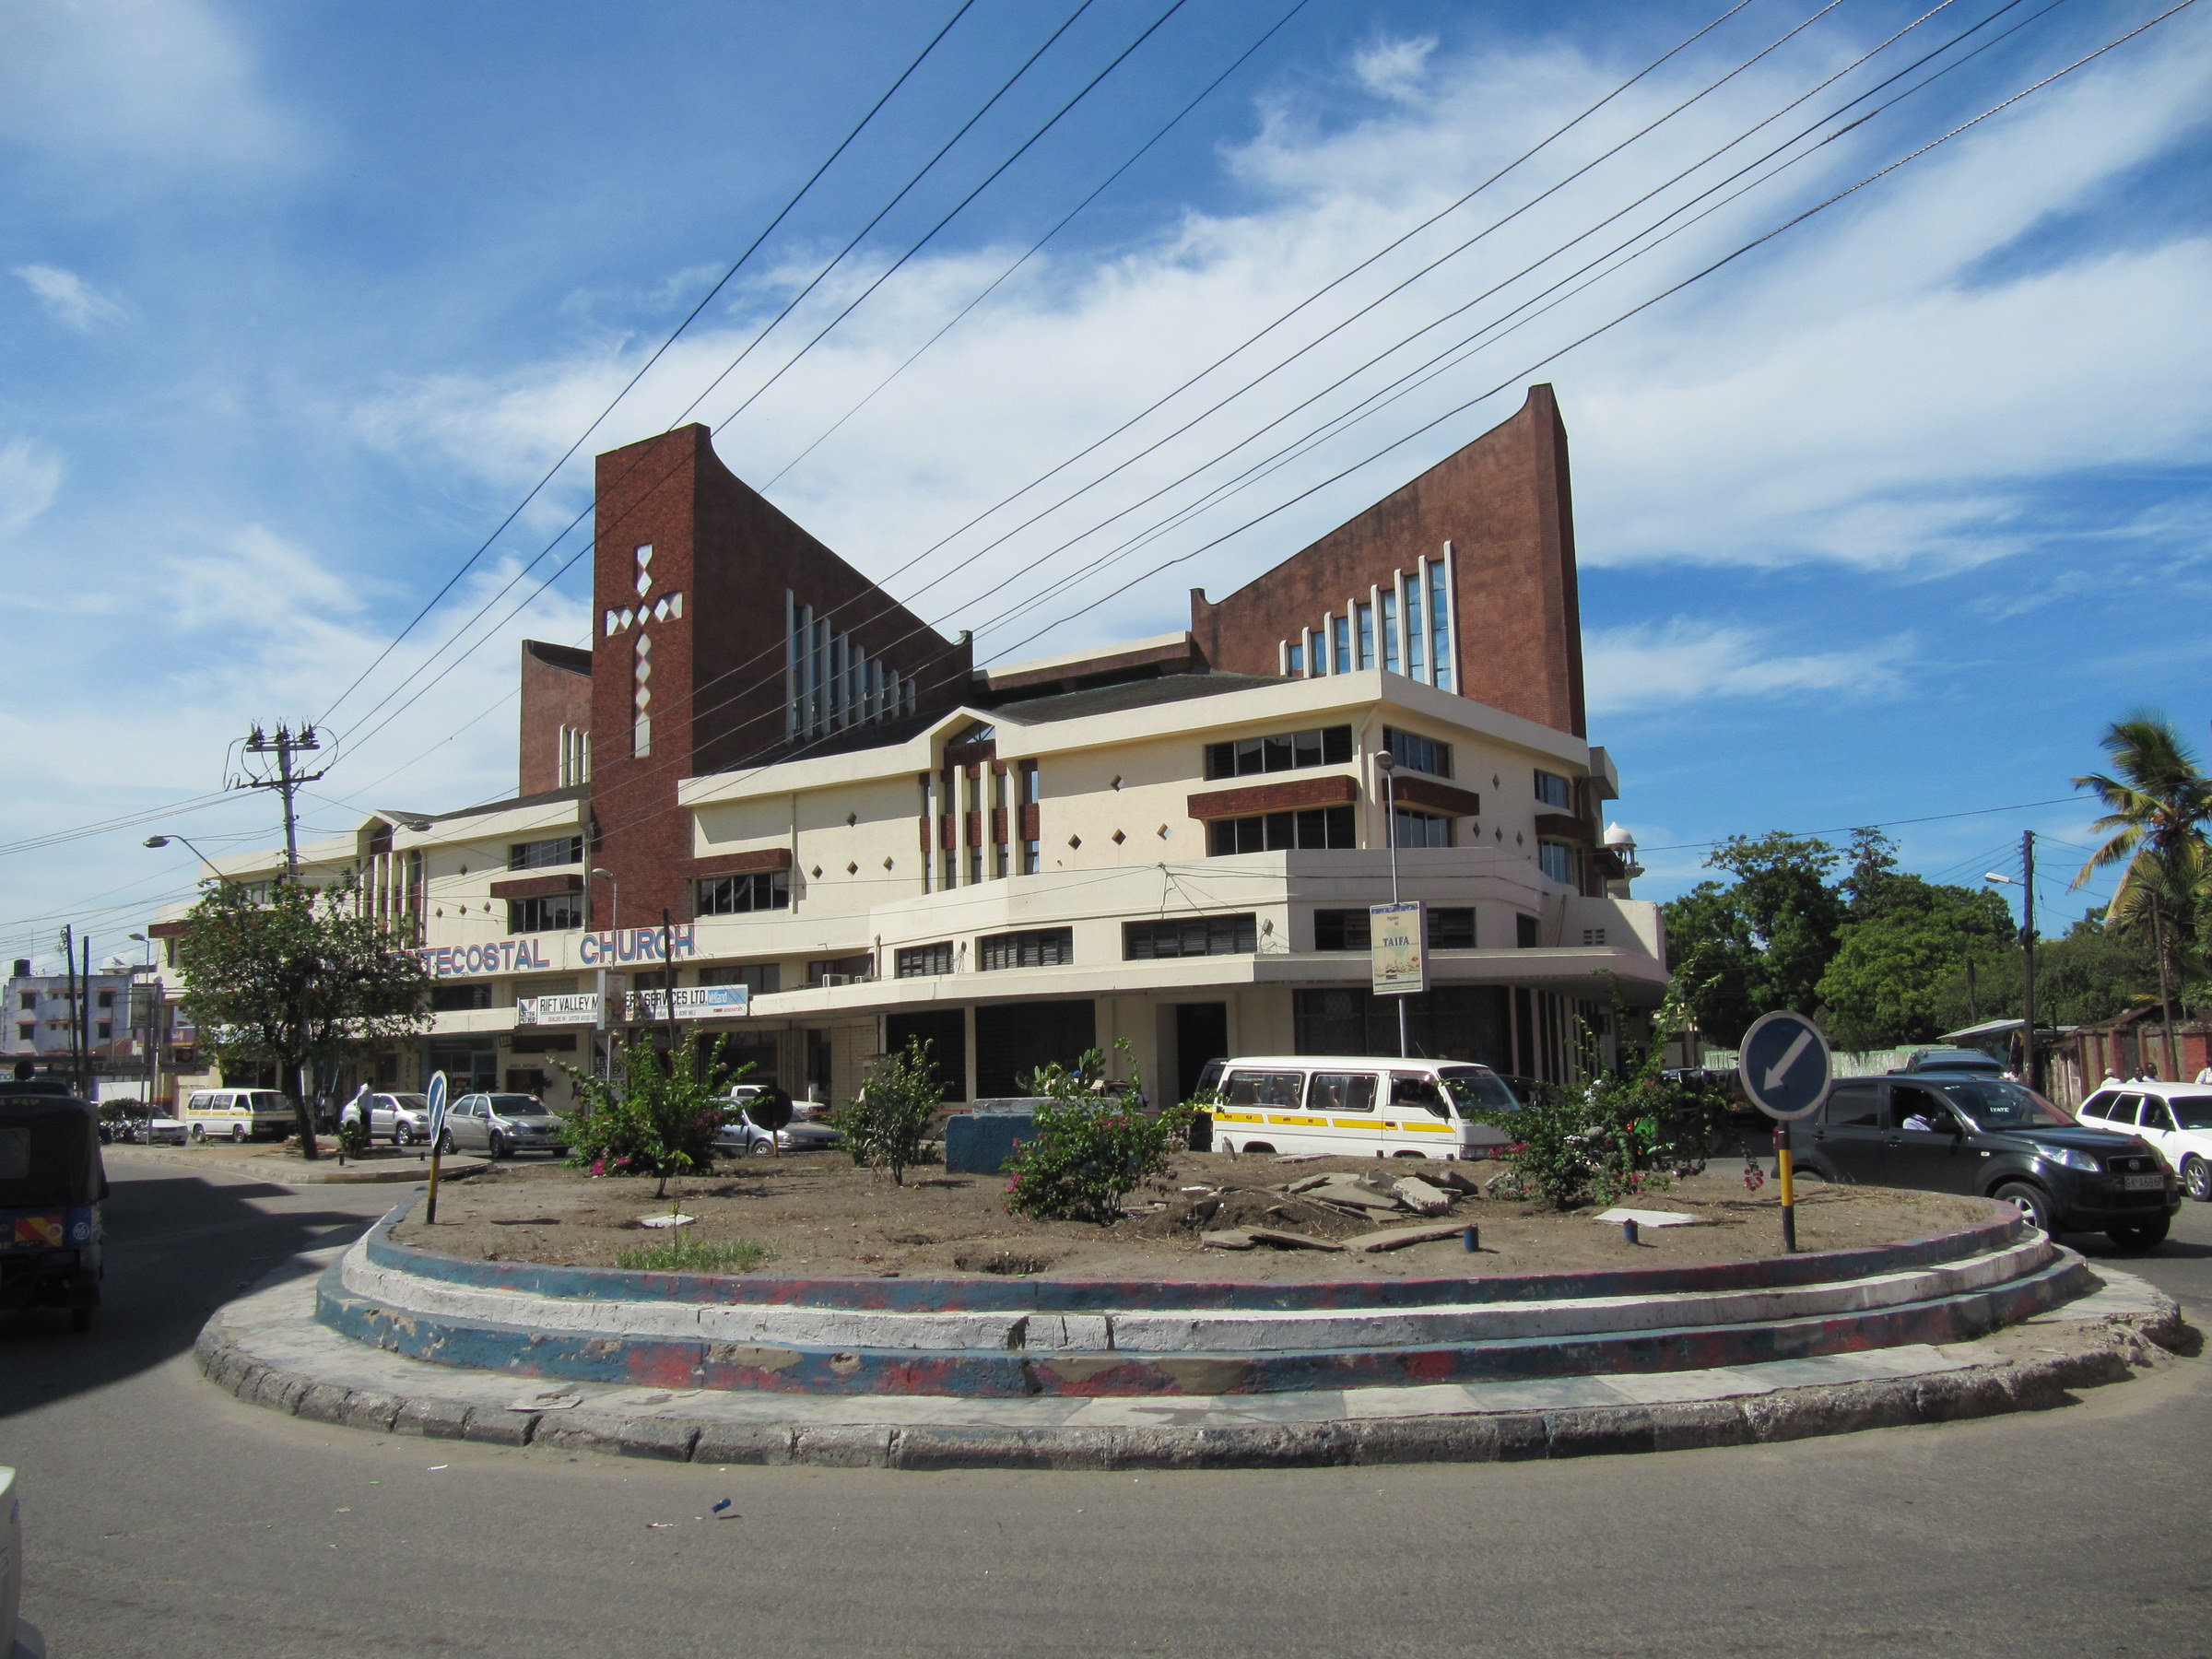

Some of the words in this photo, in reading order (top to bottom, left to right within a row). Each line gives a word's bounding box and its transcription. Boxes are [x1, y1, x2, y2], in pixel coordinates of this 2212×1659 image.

[580, 924, 695, 965] CHURCH
[1382, 935, 1409, 947] TAIFA
[540, 998, 558, 1012] RIFT
[559, 995, 590, 1011] VALLEY
[644, 990, 688, 1006] SERVCES
[690, 989, 708, 1005] LTD.
[594, 1066, 622, 1075] PETER
